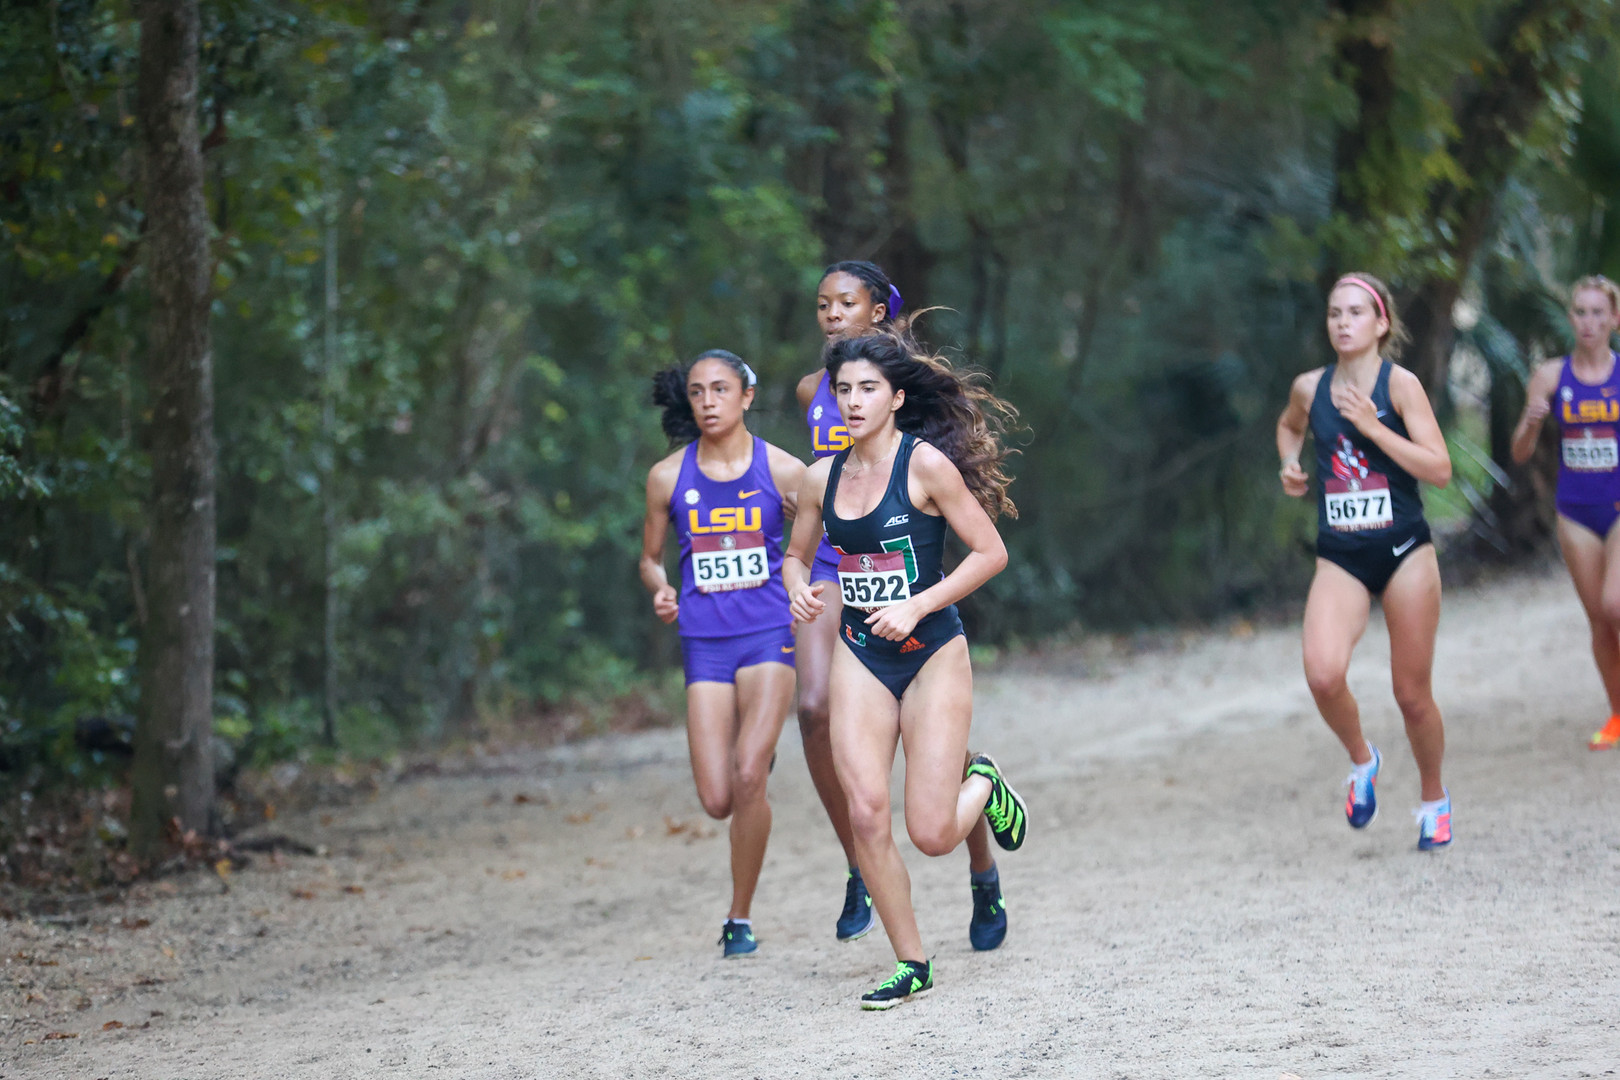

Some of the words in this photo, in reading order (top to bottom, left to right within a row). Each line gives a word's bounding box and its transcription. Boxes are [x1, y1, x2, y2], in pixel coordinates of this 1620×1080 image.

[1562, 399, 1619, 424] LSU
[688, 506, 762, 534] LSU
[885, 513, 909, 526] ACC
[1329, 496, 1386, 521] 5677
[697, 553, 763, 580] 5513
[842, 575, 907, 603] 5522
